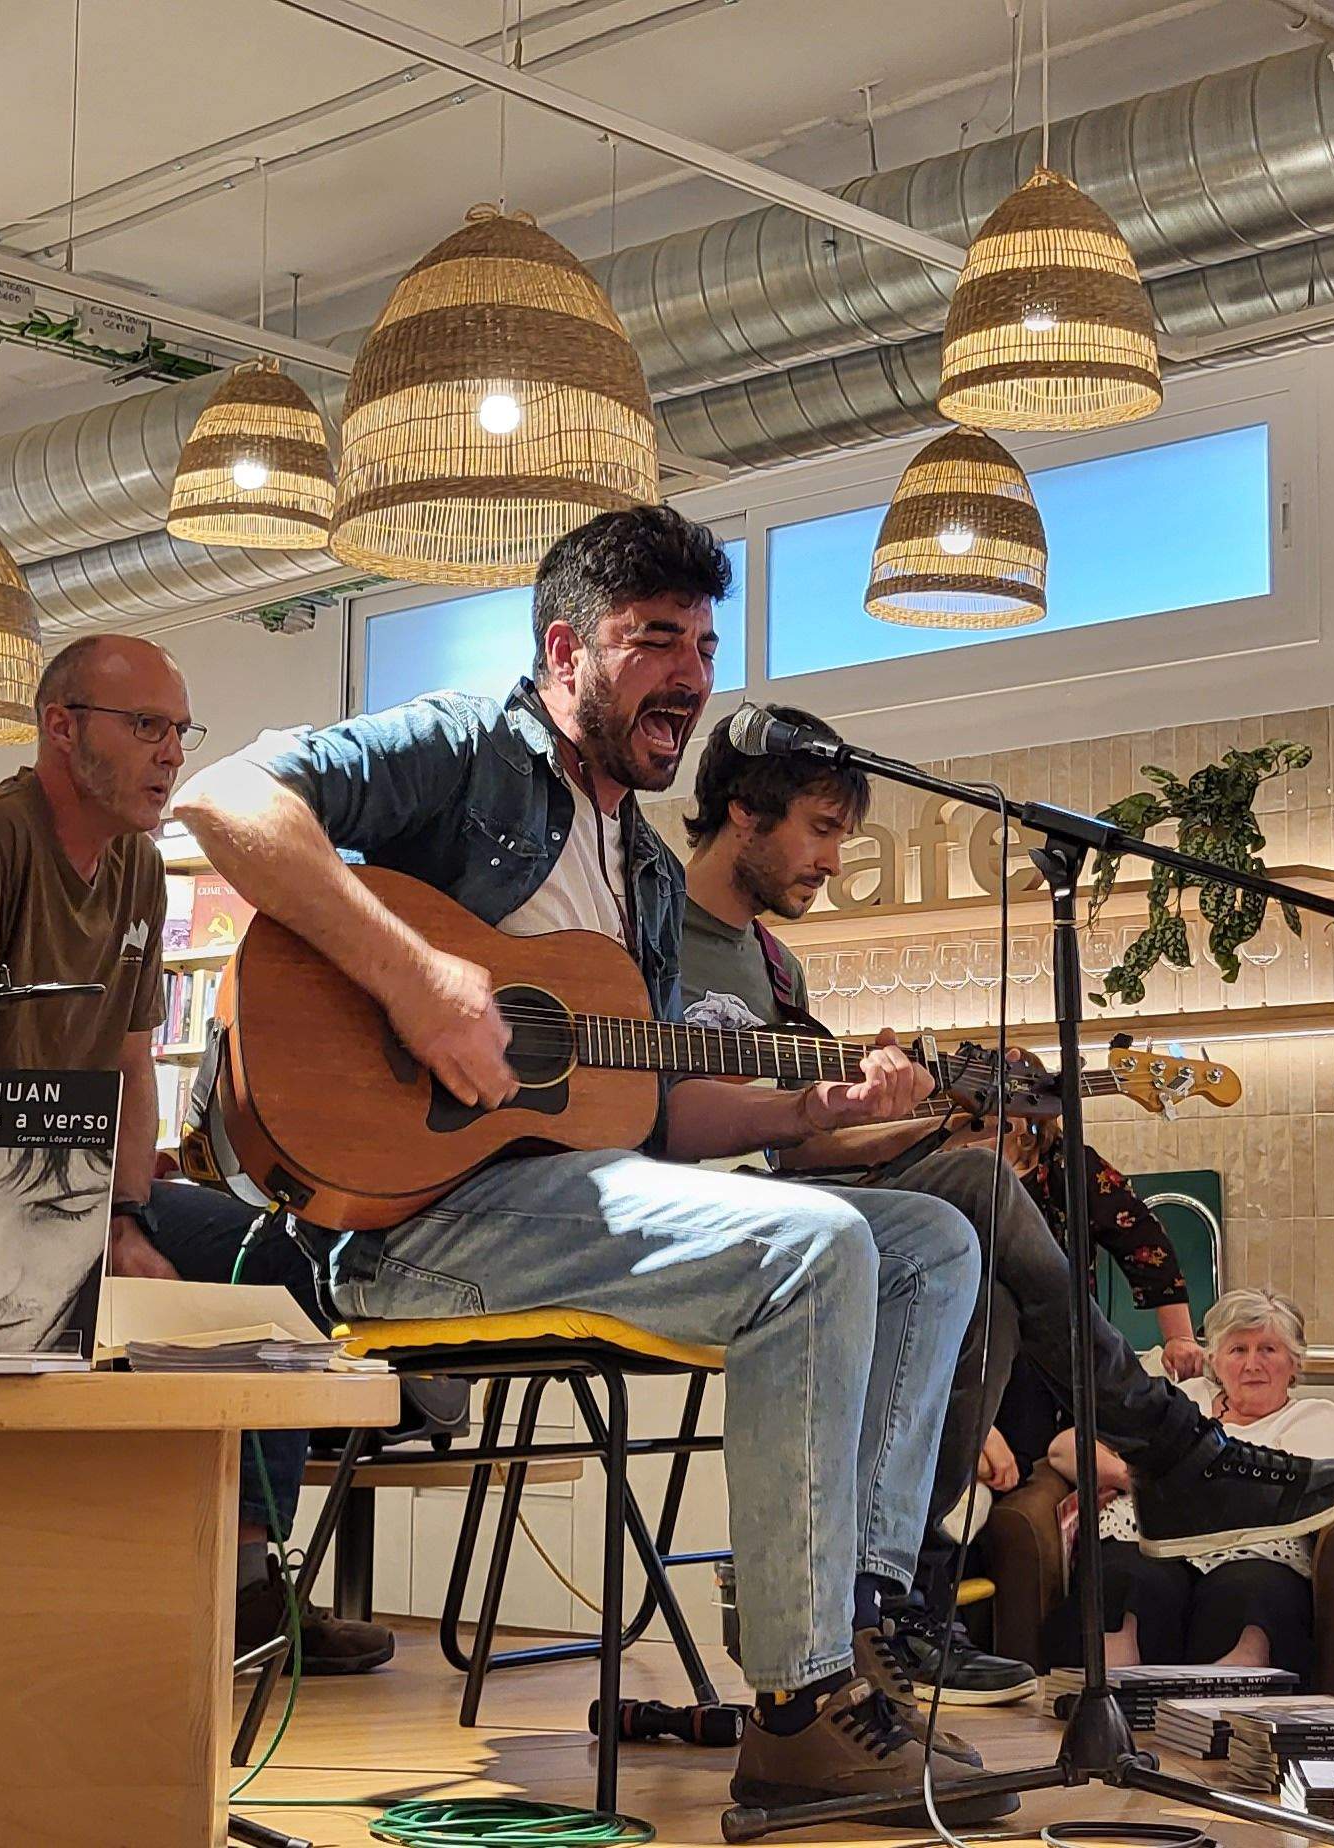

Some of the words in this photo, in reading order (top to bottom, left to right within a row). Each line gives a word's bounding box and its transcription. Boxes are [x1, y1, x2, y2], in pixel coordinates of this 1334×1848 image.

[826, 792, 1046, 909] afe
[15, 1114, 28, 1130] a
[43, 1112, 109, 1131] verso
[17, 1134, 46, 1143] Carmen
